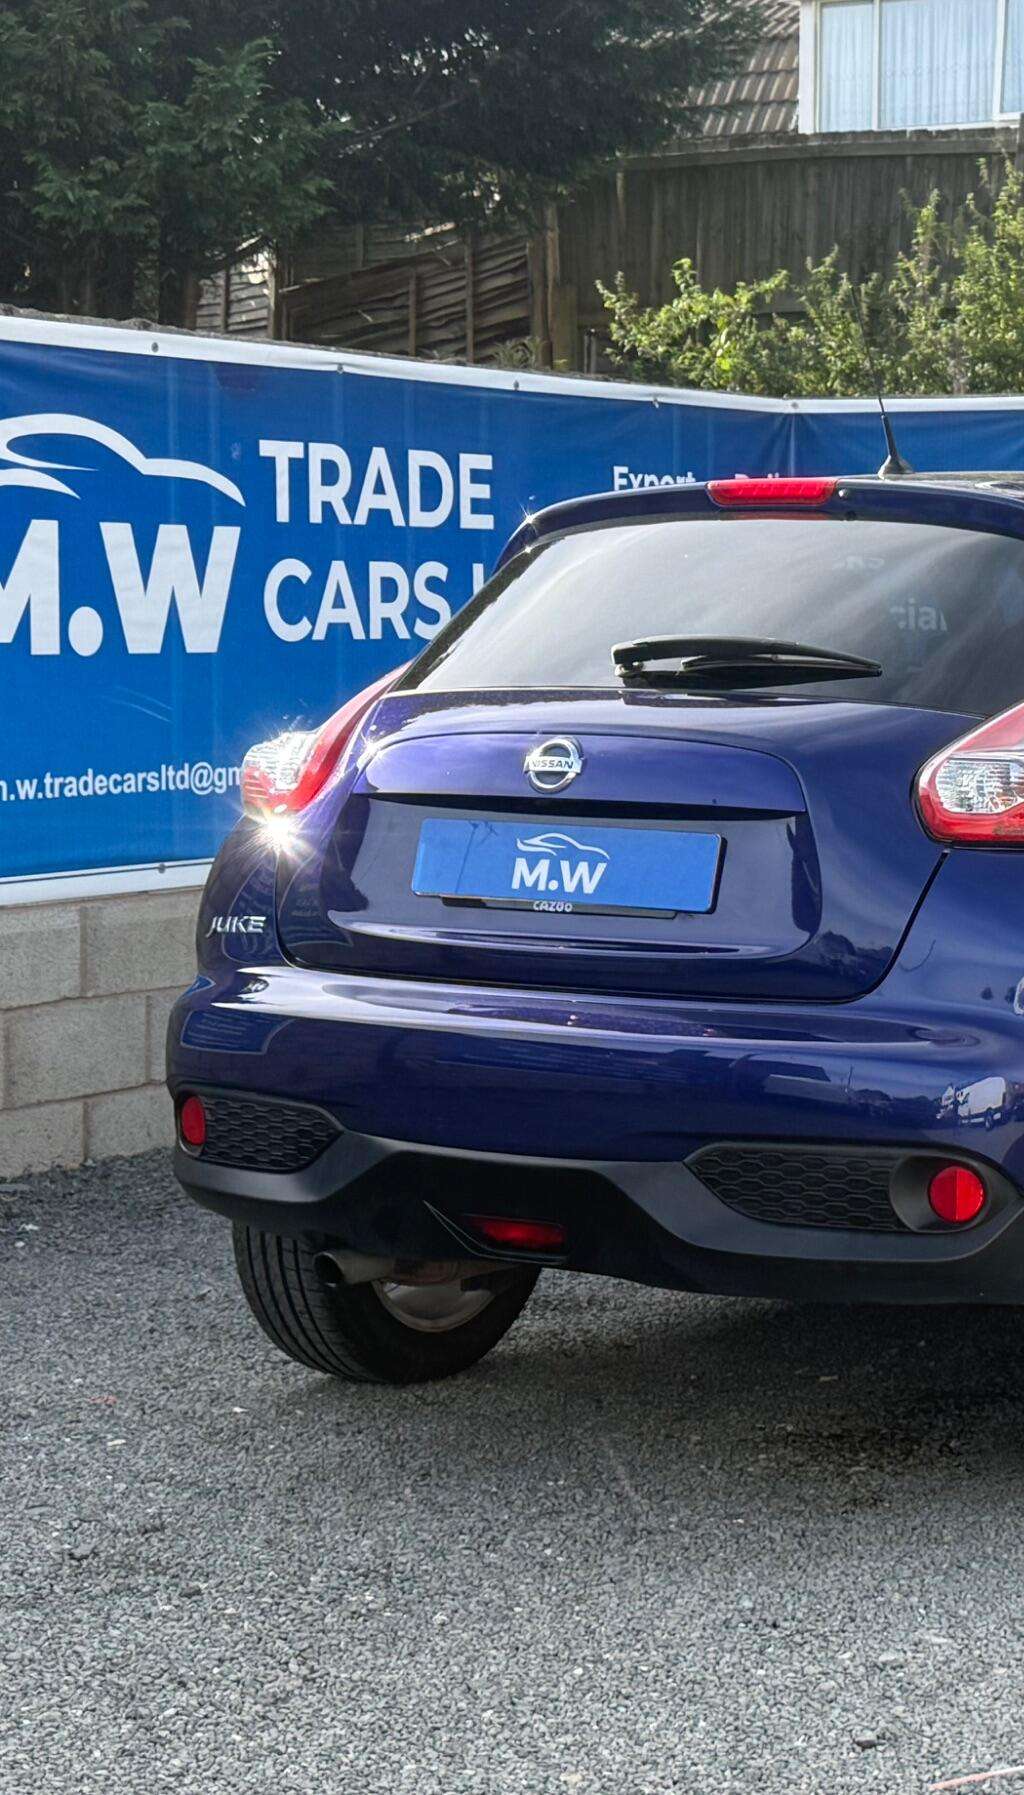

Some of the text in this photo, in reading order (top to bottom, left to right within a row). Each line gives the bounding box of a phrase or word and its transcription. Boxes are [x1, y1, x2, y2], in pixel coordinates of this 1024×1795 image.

[258, 439, 495, 530] TRADE
[263, 558, 452, 642] CARS
[530, 758, 574, 770] NISSAN
[511, 857, 608, 895] M.W
[205, 915, 267, 939] JUKE
